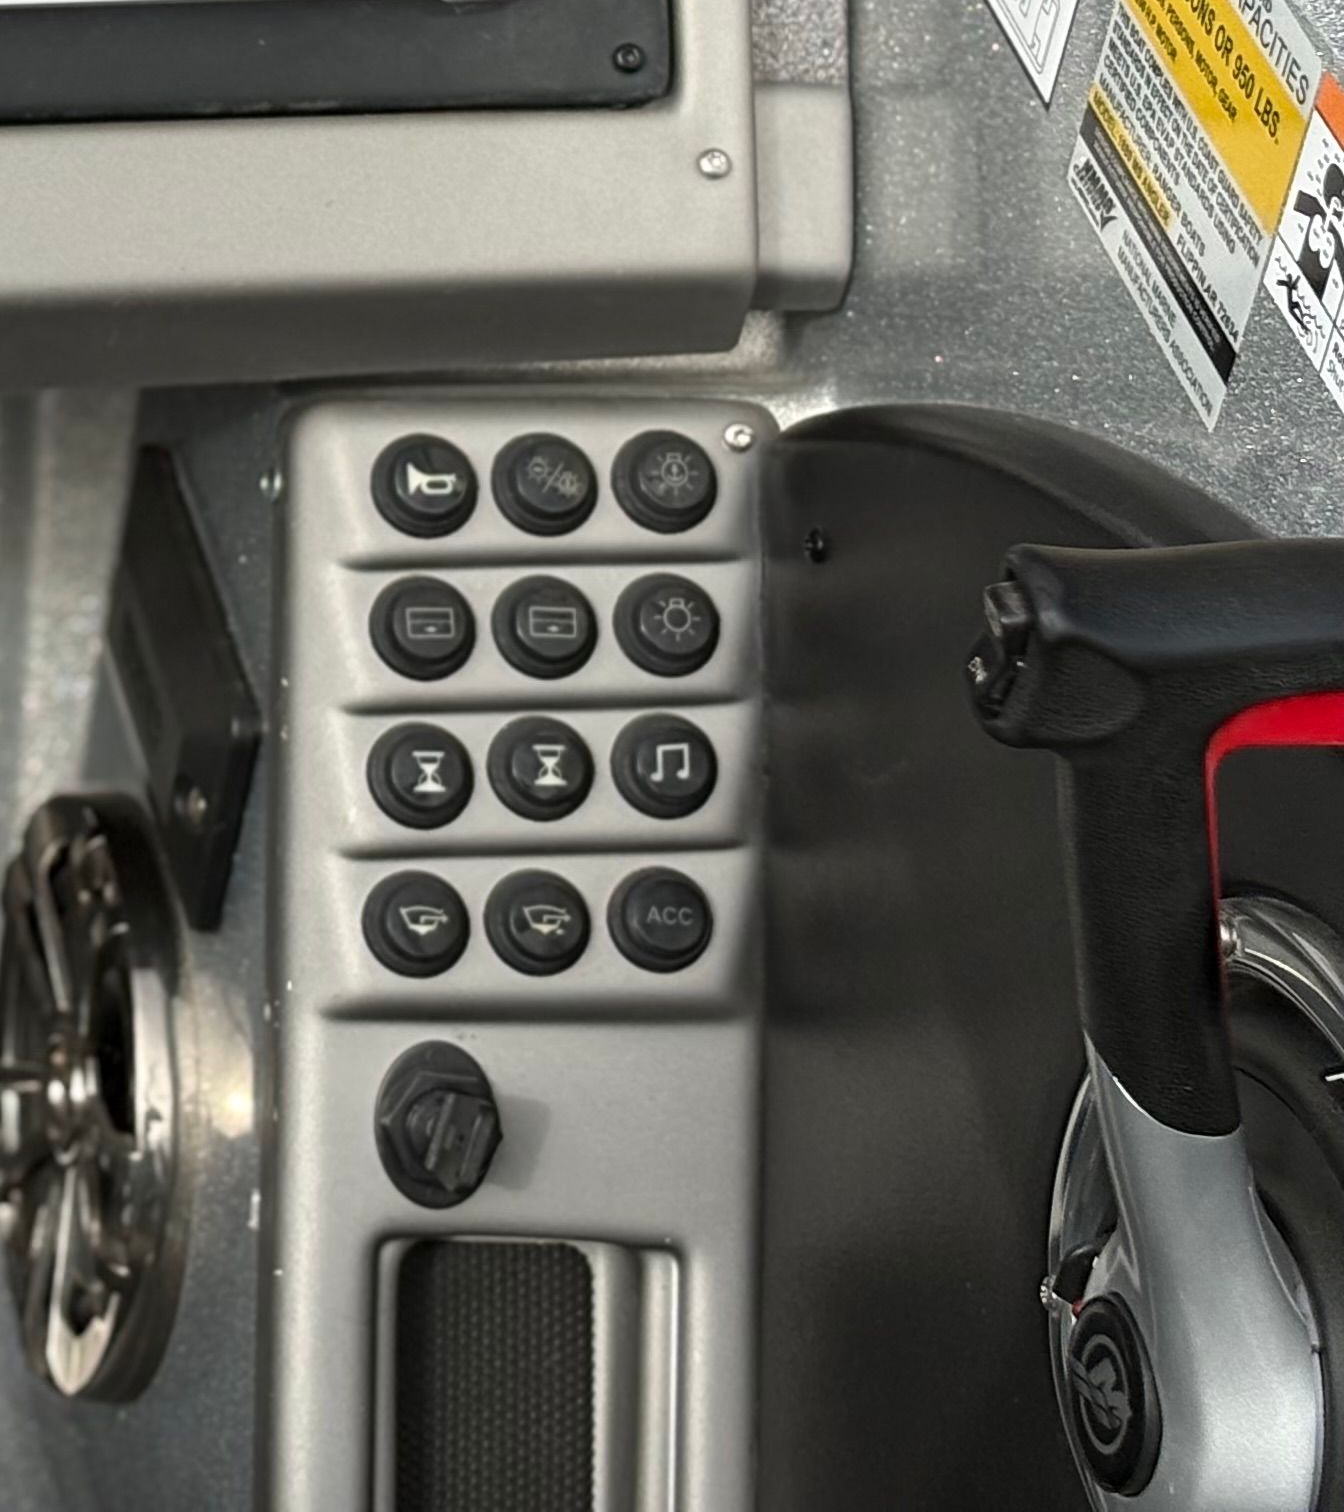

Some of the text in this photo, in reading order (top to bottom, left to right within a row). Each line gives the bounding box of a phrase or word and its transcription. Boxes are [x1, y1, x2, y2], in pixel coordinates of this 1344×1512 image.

[1104, 55, 1180, 185] CERTIFIED COMPONENTS
[1215, 25, 1233, 66] OR
[1233, 54, 1254, 99] 950
[1254, 88, 1280, 144] LBS.
[1142, 94, 1156, 121] EPA
[1156, 116, 1174, 148] EVAP
[1214, 214, 1235, 254] USING
[1152, 164, 1181, 216] RANGER
[1181, 212, 1205, 256] BOATS
[1198, 137, 1218, 173] COAST
[1218, 170, 1239, 208] GUARD
[1239, 203, 1262, 245] SAFETY
[1123, 230, 1176, 328] NATIONAL MARINE
[1170, 340, 1212, 416] ASSOCIATION
